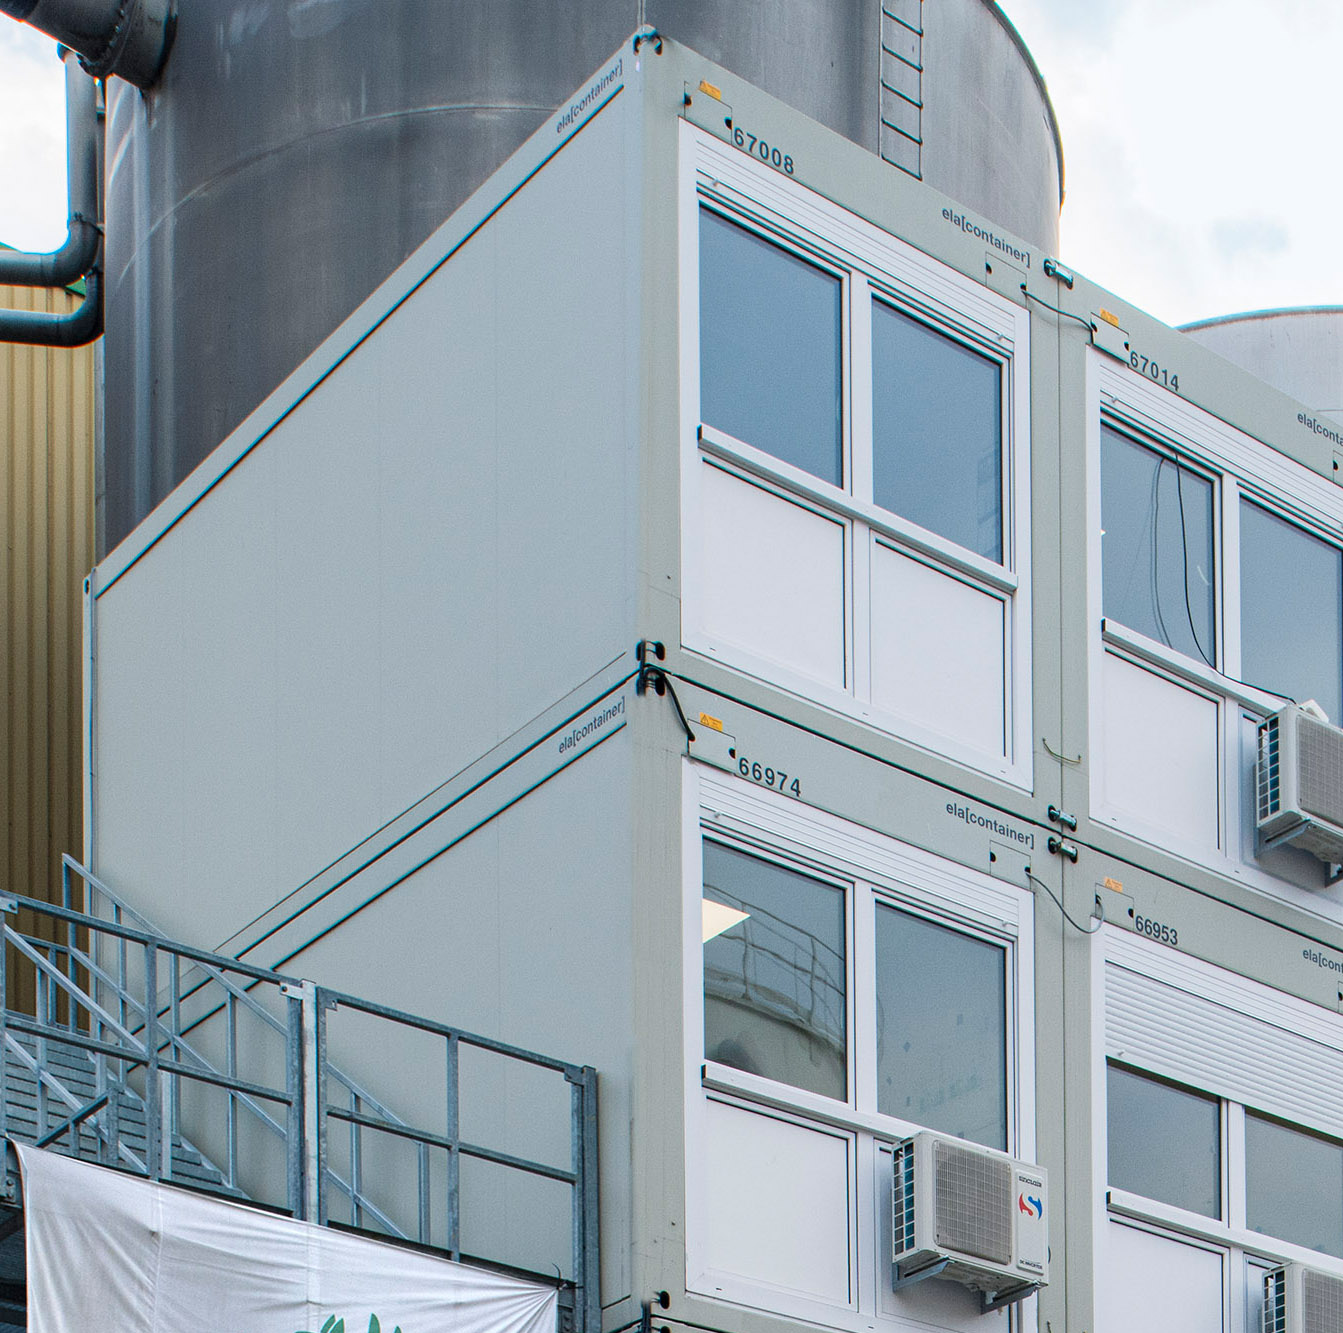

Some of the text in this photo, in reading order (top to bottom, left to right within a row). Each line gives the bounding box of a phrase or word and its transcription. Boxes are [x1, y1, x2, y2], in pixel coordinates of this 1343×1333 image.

[556, 58, 623, 133] ela[container]
[733, 127, 794, 175] 67008
[942, 208, 1031, 269] ela[container]
[1130, 350, 1180, 392] 67014
[558, 696, 626, 754] ela[container]
[739, 757, 801, 797] 66974
[946, 803, 1035, 850] ela[container]
[1135, 915, 1178, 946] 66953
